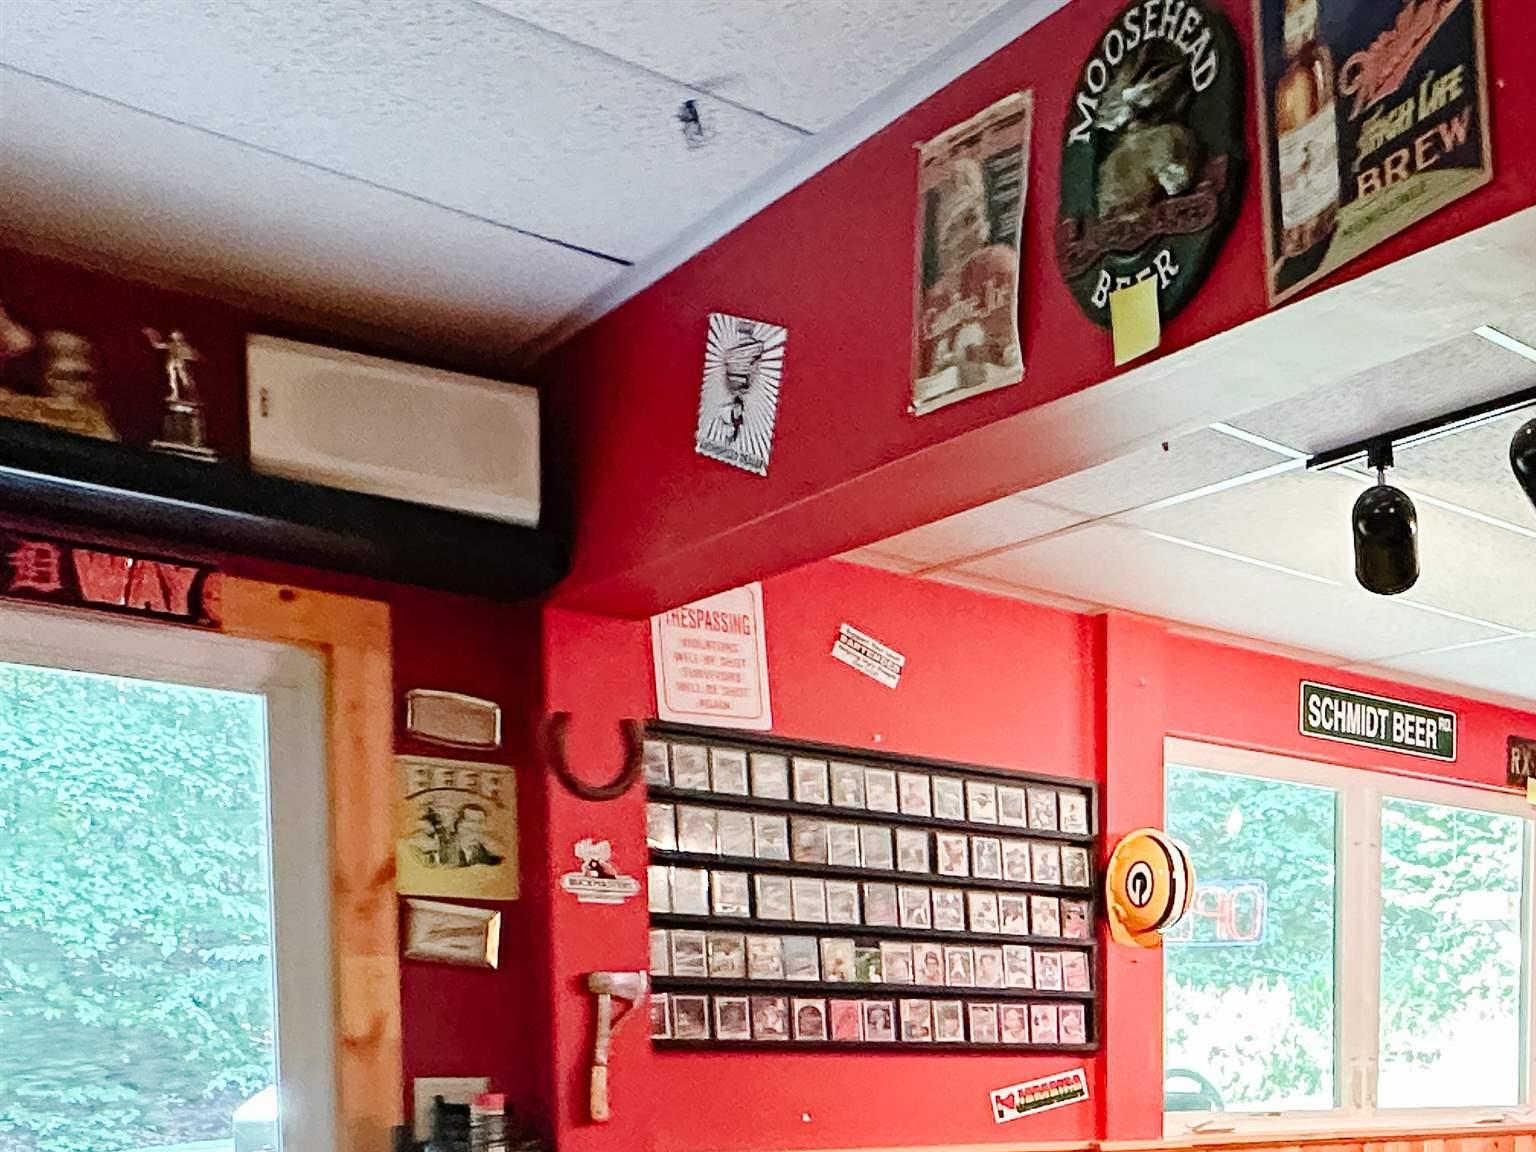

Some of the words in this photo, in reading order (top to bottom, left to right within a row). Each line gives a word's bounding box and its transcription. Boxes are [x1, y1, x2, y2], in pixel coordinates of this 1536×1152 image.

[1066, 0, 1219, 146] MOOSEHEAD
[1357, 105, 1473, 198] BREW
[1308, 693, 1390, 740] SCHMIDT
[1392, 711, 1438, 750] BEER
